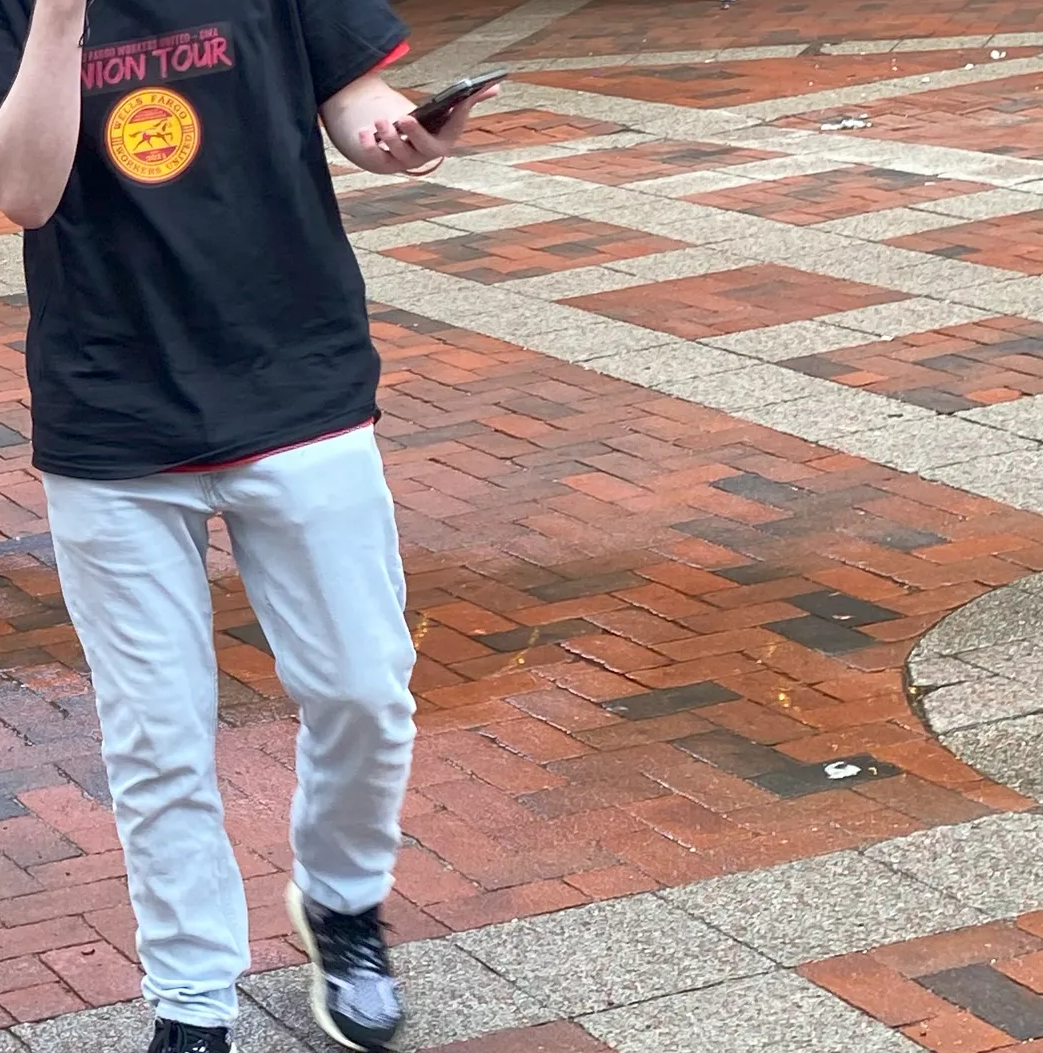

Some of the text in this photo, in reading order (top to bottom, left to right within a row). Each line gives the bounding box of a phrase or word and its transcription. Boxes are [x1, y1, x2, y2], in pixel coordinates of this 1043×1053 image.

[81, 37, 233, 90] NION TOUR
[114, 94, 188, 130] WELLS FARGO
[116, 134, 193, 175] WORKERS UNITED
